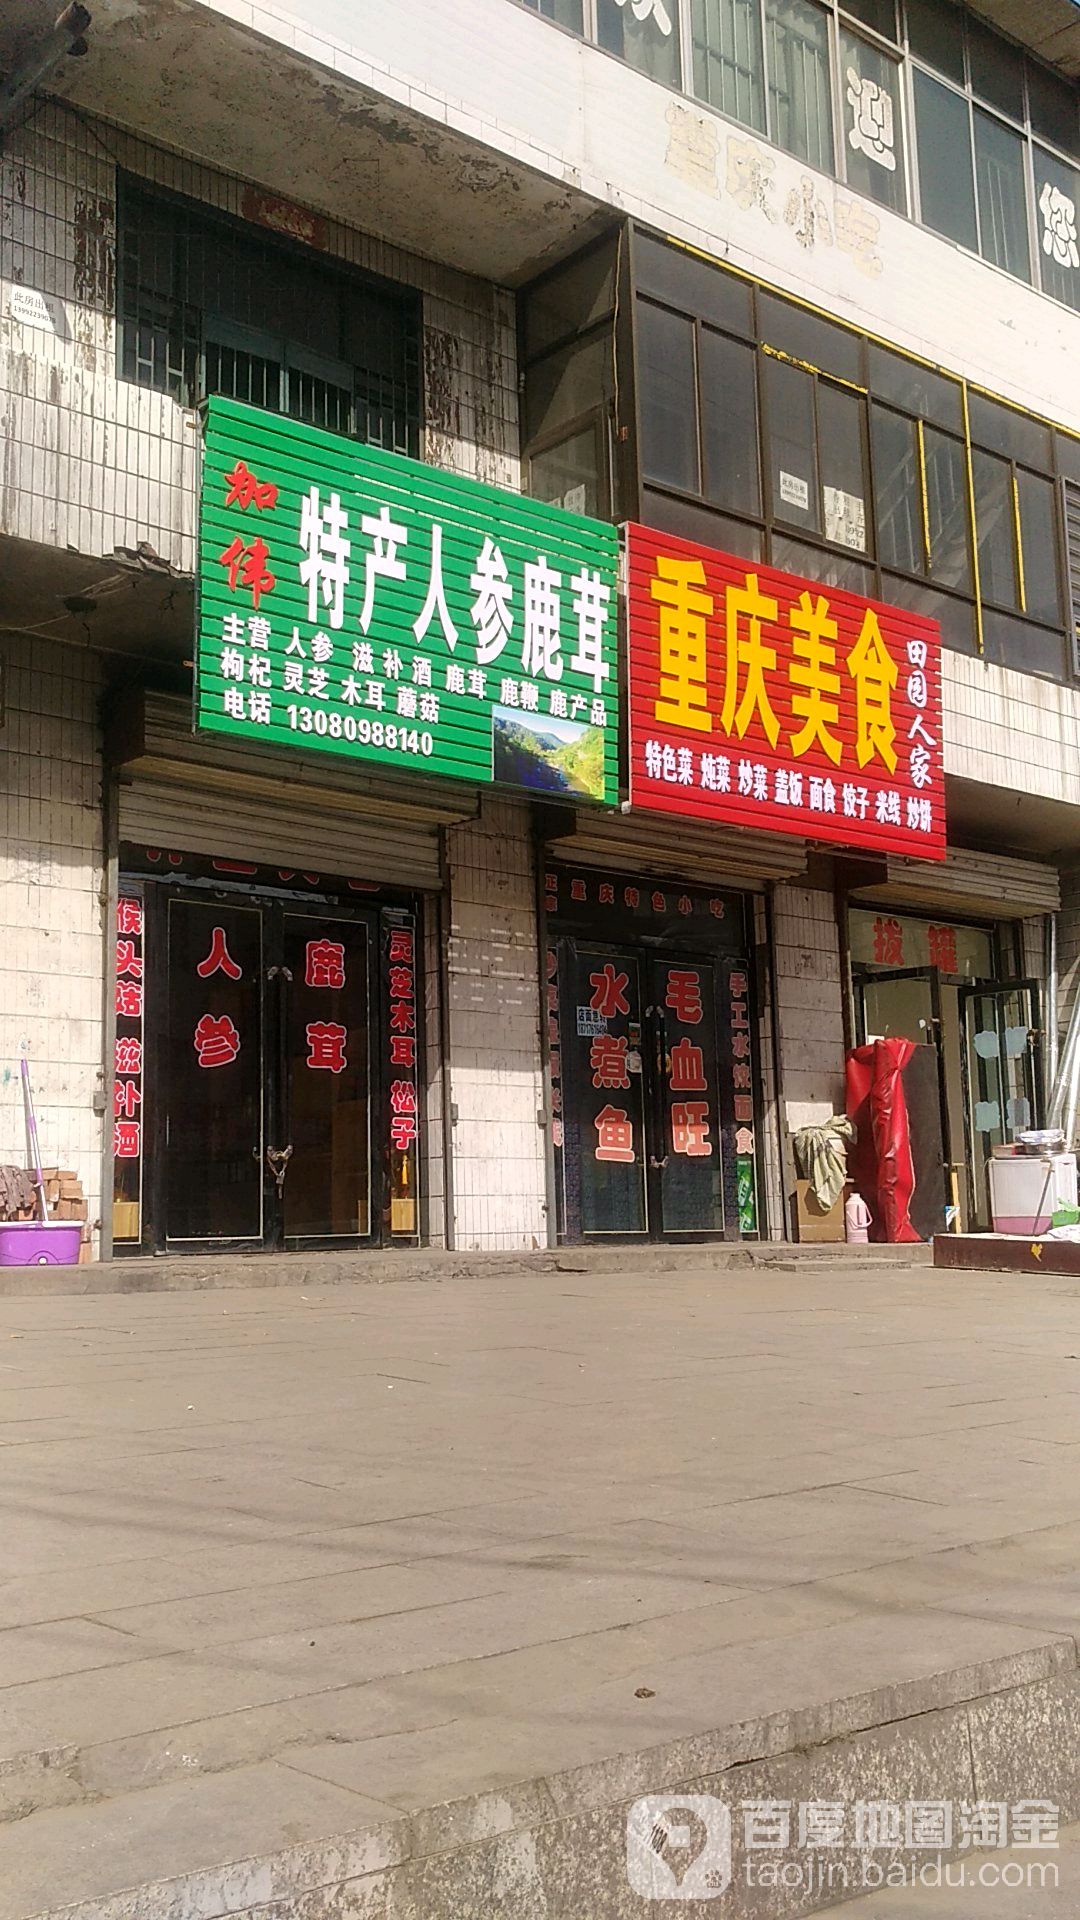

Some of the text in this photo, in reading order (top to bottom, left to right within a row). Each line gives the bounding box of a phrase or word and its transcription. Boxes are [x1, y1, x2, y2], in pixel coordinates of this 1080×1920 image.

[846, 66, 1079, 267] 迎 您
[219, 460, 279, 612] 加伟
[300, 486, 610, 694] 特产人参鹿茸
[221, 647, 440, 724] 枸杞 灵芝 木耳 蘑菇
[222, 613, 607, 727] 主营 人参 滋补酒 鹿茸 鹿鞭 鹿产品
[223, 687, 433, 756] 电话 13080988140
[651, 555, 898, 775] 重庆美食
[907, 640, 937, 788] 田园人家
[645, 740, 693, 785] 特色菜
[701, 753, 731, 792] 炖菜
[738, 759, 768, 800] 炒菜
[774, 768, 803, 806] 盖饭
[809, 776, 836, 813] 面食
[842, 783, 869, 819] 饺子
[875, 790, 901, 825] 米线
[571, 878, 724, 919] 重庆特色小吃
[194, 926, 242, 1068] 人参
[305, 938, 347, 1073] 鹿茸
[590, 963, 635, 1163] 水煮鱼
[666, 970, 712, 1157] 毛血旺
